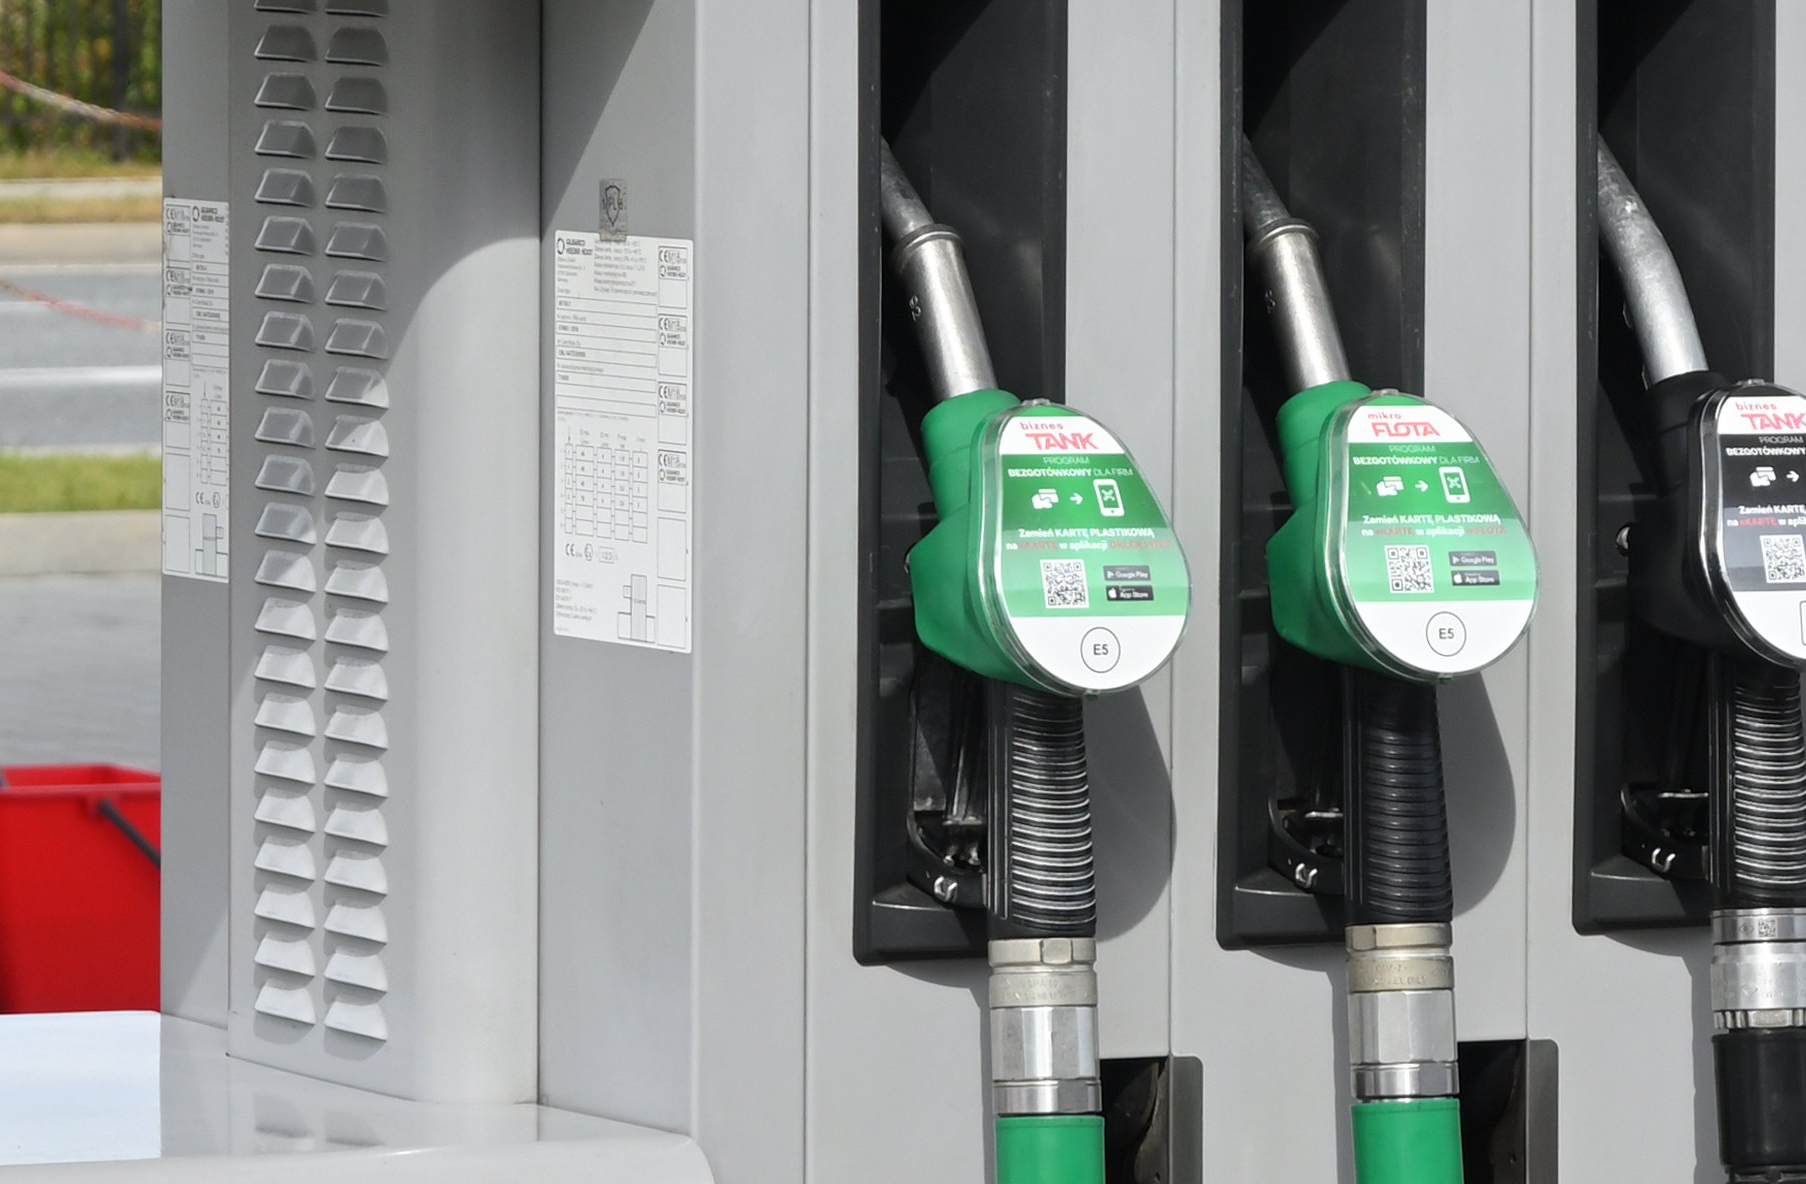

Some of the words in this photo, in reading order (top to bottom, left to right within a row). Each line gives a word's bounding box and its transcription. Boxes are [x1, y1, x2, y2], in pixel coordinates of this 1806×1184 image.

[1735, 402, 1777, 411] biznes
[1020, 421, 1063, 430] biznes
[1371, 422, 1440, 437] FLOTA
[1025, 432, 1099, 450] TANK
[1439, 628, 1454, 640] E5
[1093, 645, 1109, 655] E5
